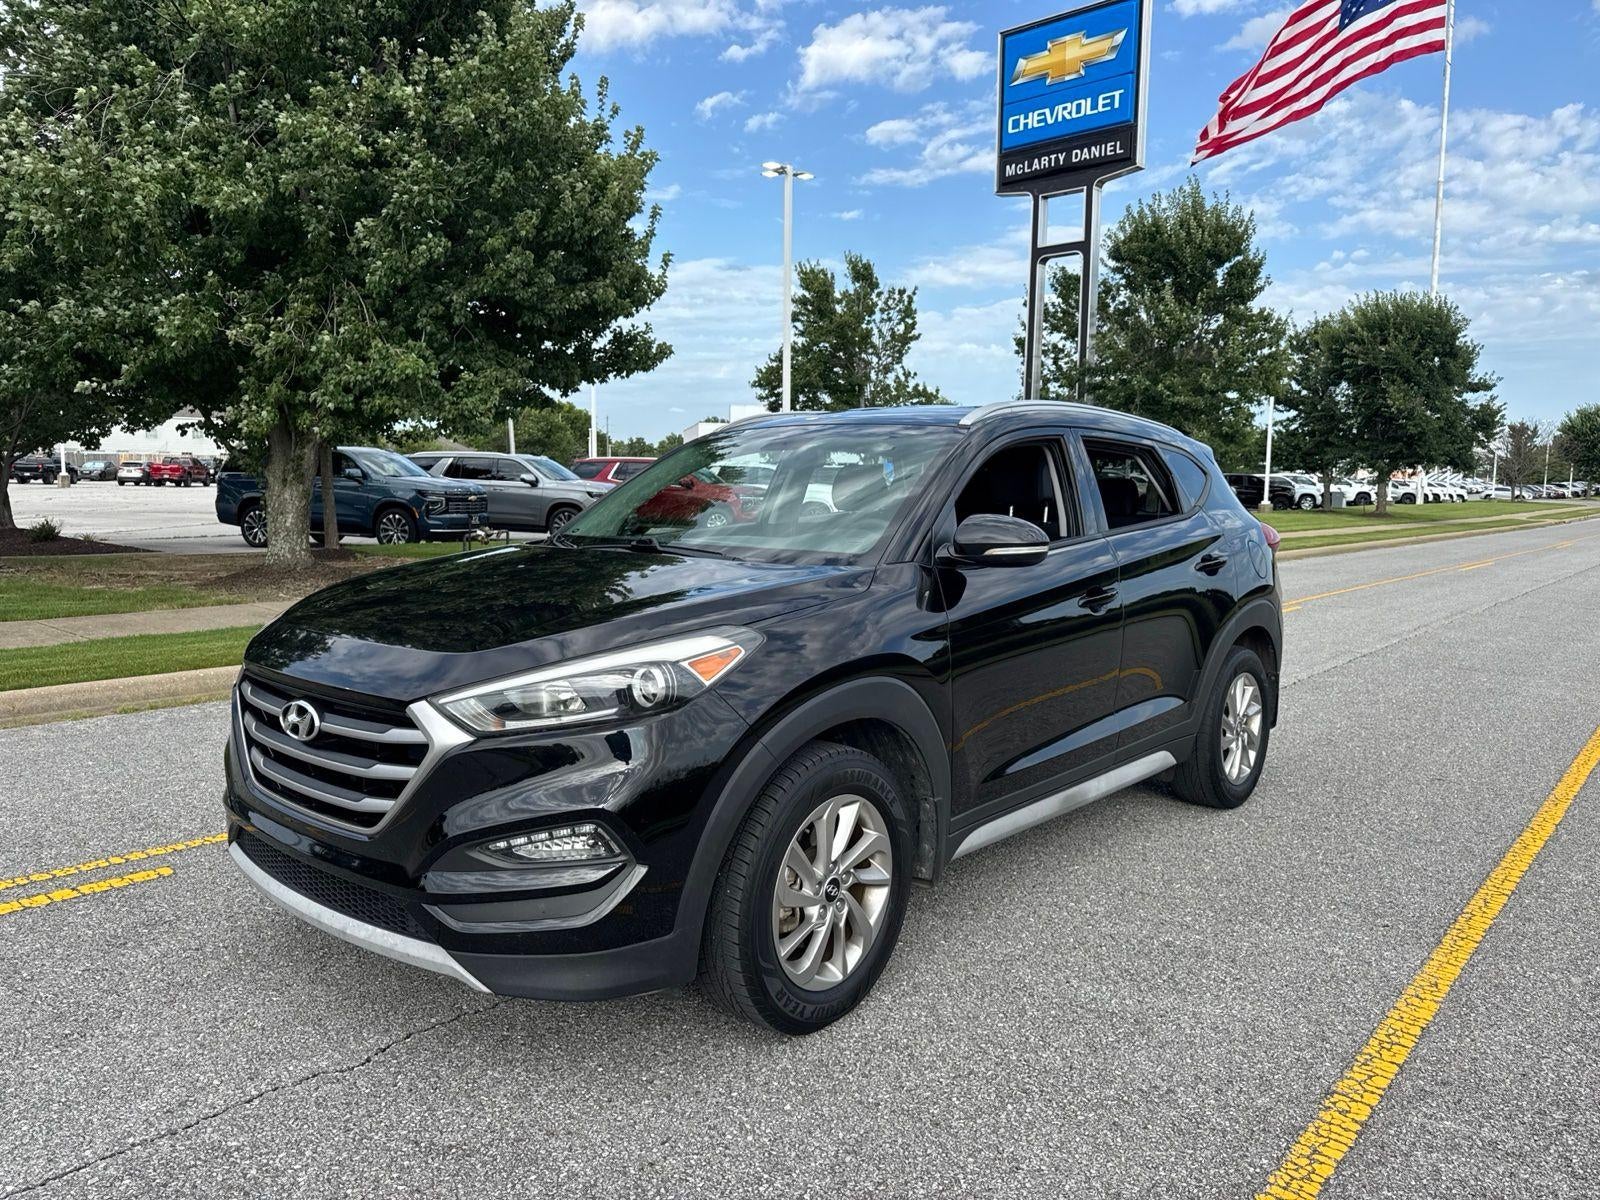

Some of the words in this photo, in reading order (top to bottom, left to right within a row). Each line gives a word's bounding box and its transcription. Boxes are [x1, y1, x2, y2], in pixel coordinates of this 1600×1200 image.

[1007, 89, 1125, 134] CHEVROLET
[1005, 152, 1067, 177] McLARTY
[1071, 141, 1124, 163] DANIEL
